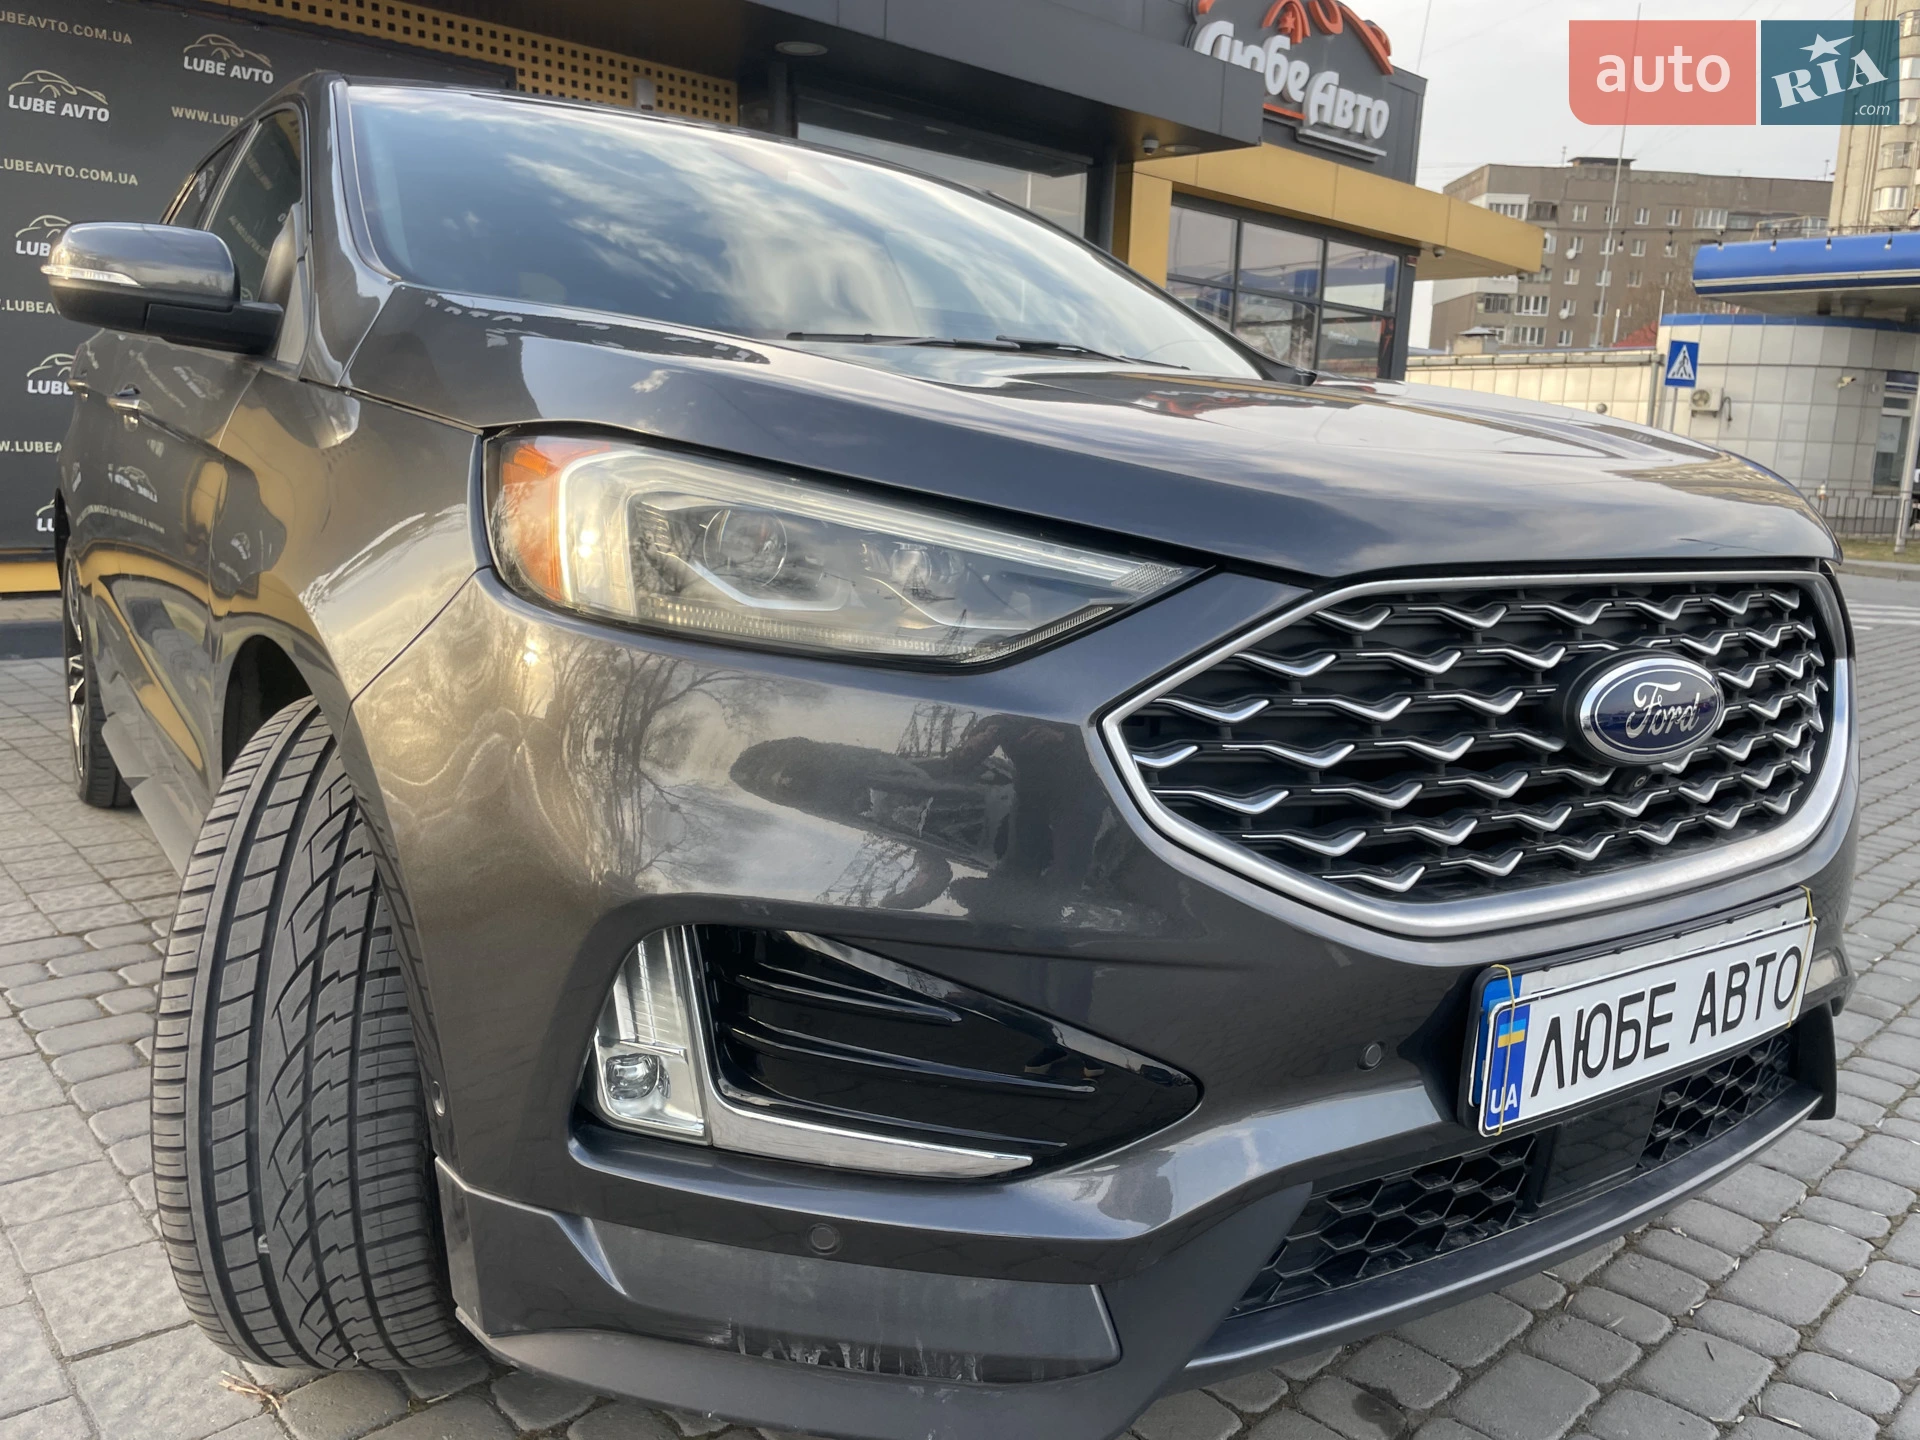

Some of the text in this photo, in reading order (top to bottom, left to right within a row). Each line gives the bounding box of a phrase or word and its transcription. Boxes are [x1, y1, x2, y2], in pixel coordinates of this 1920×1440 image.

[183, 56, 274, 84] LUBE AVTO
[8, 94, 110, 122] LUBE AVTO
[171, 106, 243, 127] WWW.LUB
[0, 298, 55, 314] .LUBEA
[1626, 682, 1700, 739] Ford
[1530, 945, 1802, 1098] ЛЮБЕ АВТО
[1490, 1086, 1518, 1114] UA
